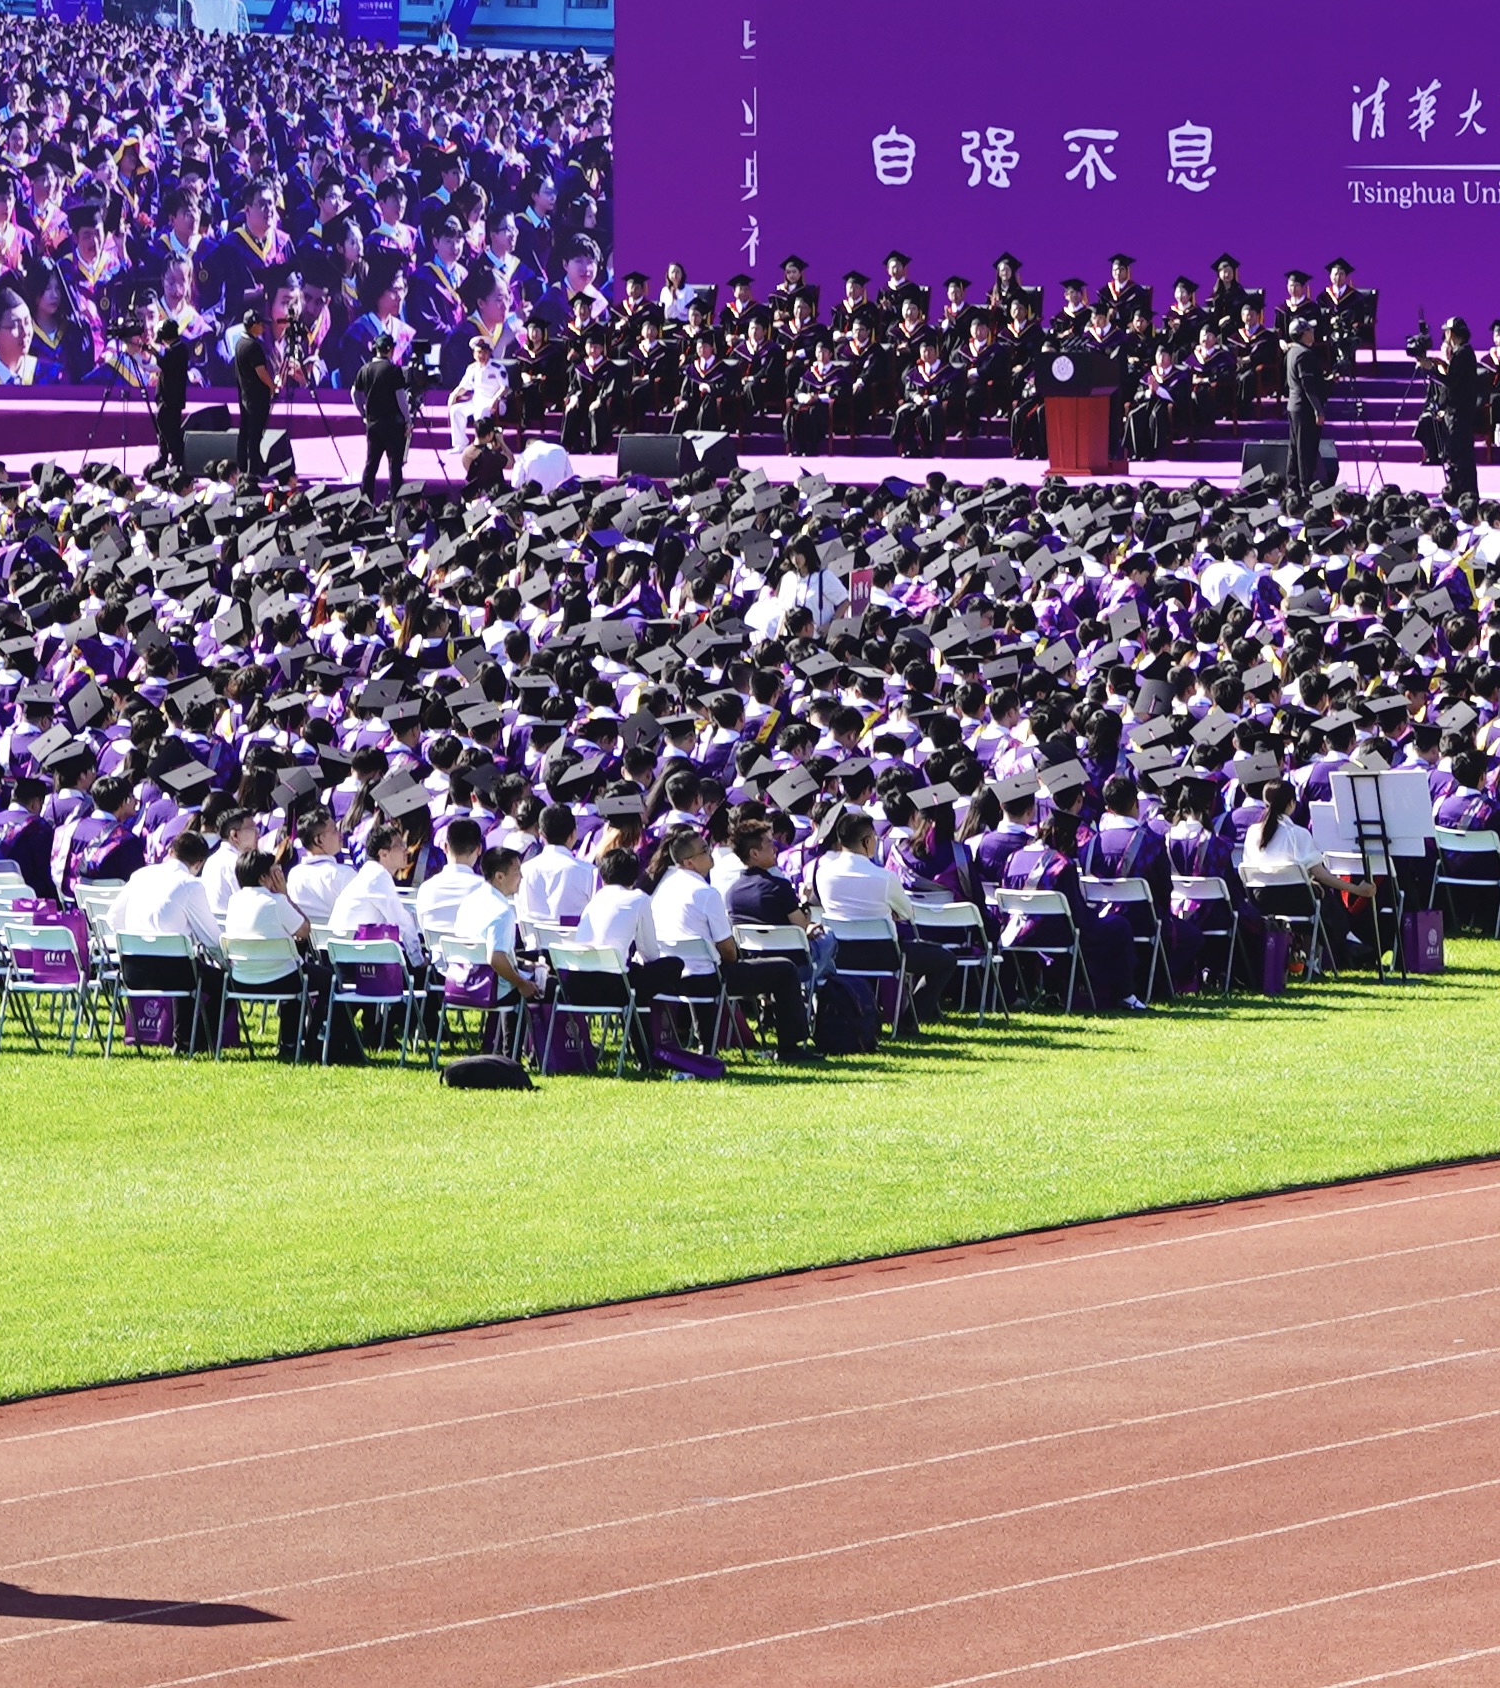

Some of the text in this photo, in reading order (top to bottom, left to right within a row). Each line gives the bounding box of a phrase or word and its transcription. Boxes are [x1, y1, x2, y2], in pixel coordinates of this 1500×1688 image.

[871, 119, 1218, 193] 自强不息
[1348, 181, 1456, 209] Tsinghua
